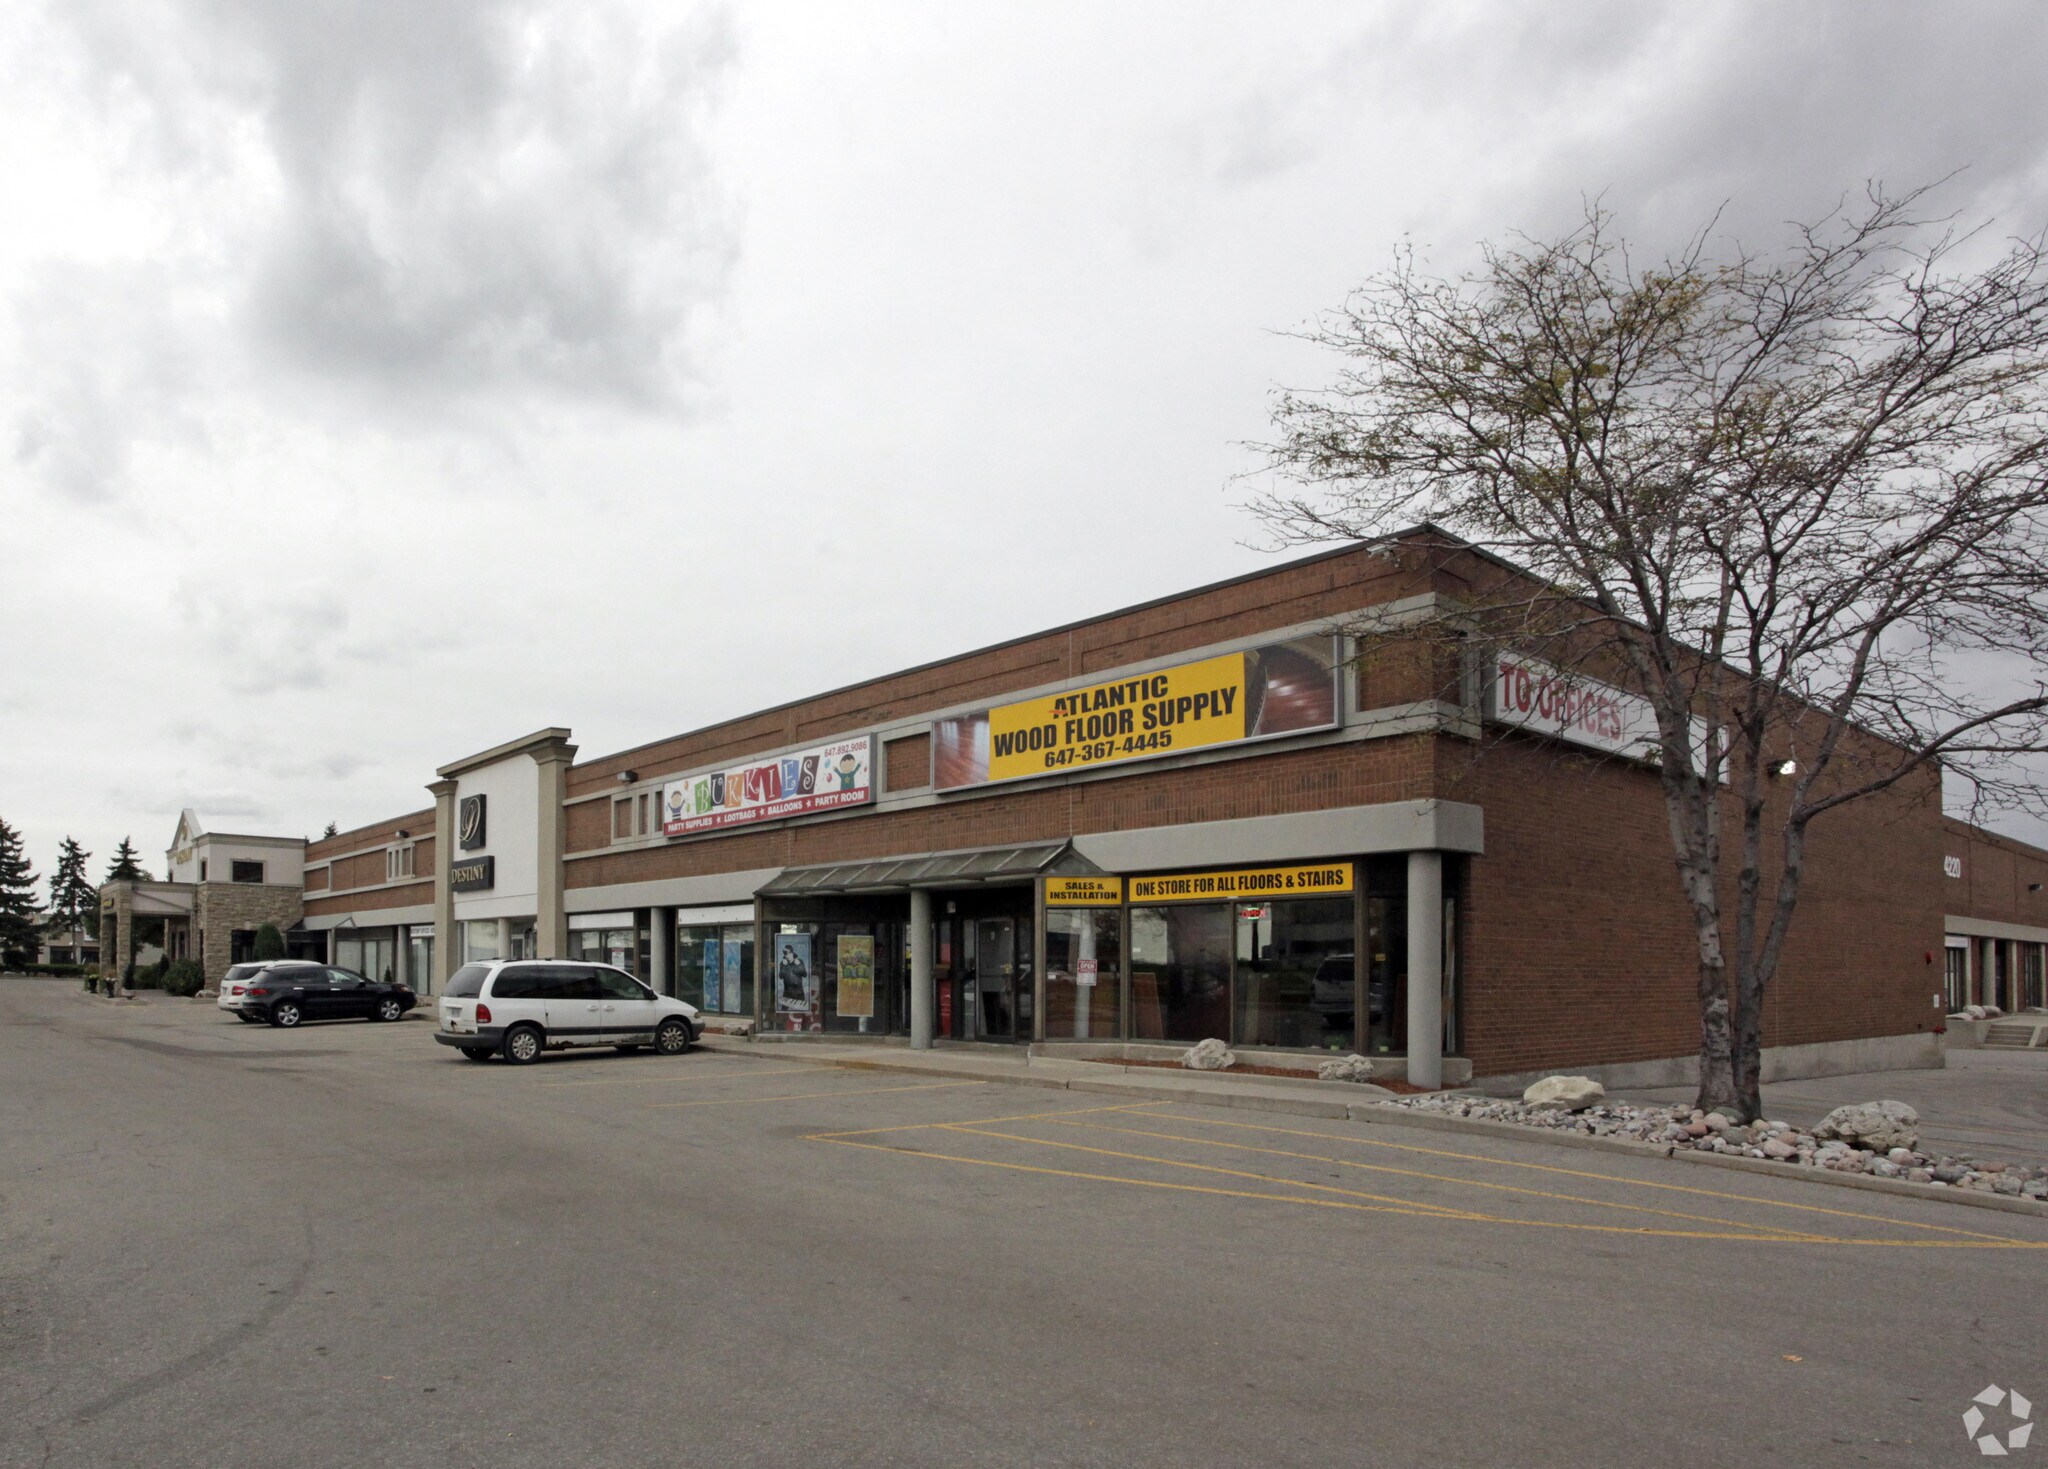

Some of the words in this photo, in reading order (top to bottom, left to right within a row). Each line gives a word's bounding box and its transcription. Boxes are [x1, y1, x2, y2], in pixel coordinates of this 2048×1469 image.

[1052, 675, 1168, 719] ATLANTIC
[1501, 661, 1531, 713] TO
[1538, 675, 1621, 741] OFFICES
[994, 724, 1058, 758] WOOD
[1065, 708, 1134, 745] FLOOR
[1142, 686, 1237, 730] SUPPLY
[824, 740, 868, 757] 647.892.9086
[1045, 730, 1172, 767] 647-367-4445
[698, 759, 815, 814] BUKKIES
[667, 820, 685, 833] PARTY
[685, 817, 713, 829] SUPPLIES
[724, 809, 756, 823] LOOTBAGS
[767, 800, 803, 815] BALLOONS
[814, 794, 839, 807] PARTY
[841, 790, 865, 803] ROOM
[451, 863, 485, 884] DESTINY
[1944, 855, 1961, 879] 4220
[1049, 891, 1118, 900] INSTALLATION
[1065, 881, 1094, 891] SALES
[1096, 881, 1104, 890] &
[1135, 881, 1156, 896] ONE
[1158, 879, 1191, 895] STORE
[1194, 878, 1215, 892] FOR
[1217, 876, 1235, 891] ALL
[1238, 873, 1283, 890] FLOORS
[1285, 874, 1295, 888] &
[1297, 869, 1344, 887] STAIRS
[1240, 908, 1267, 918] OPEN
